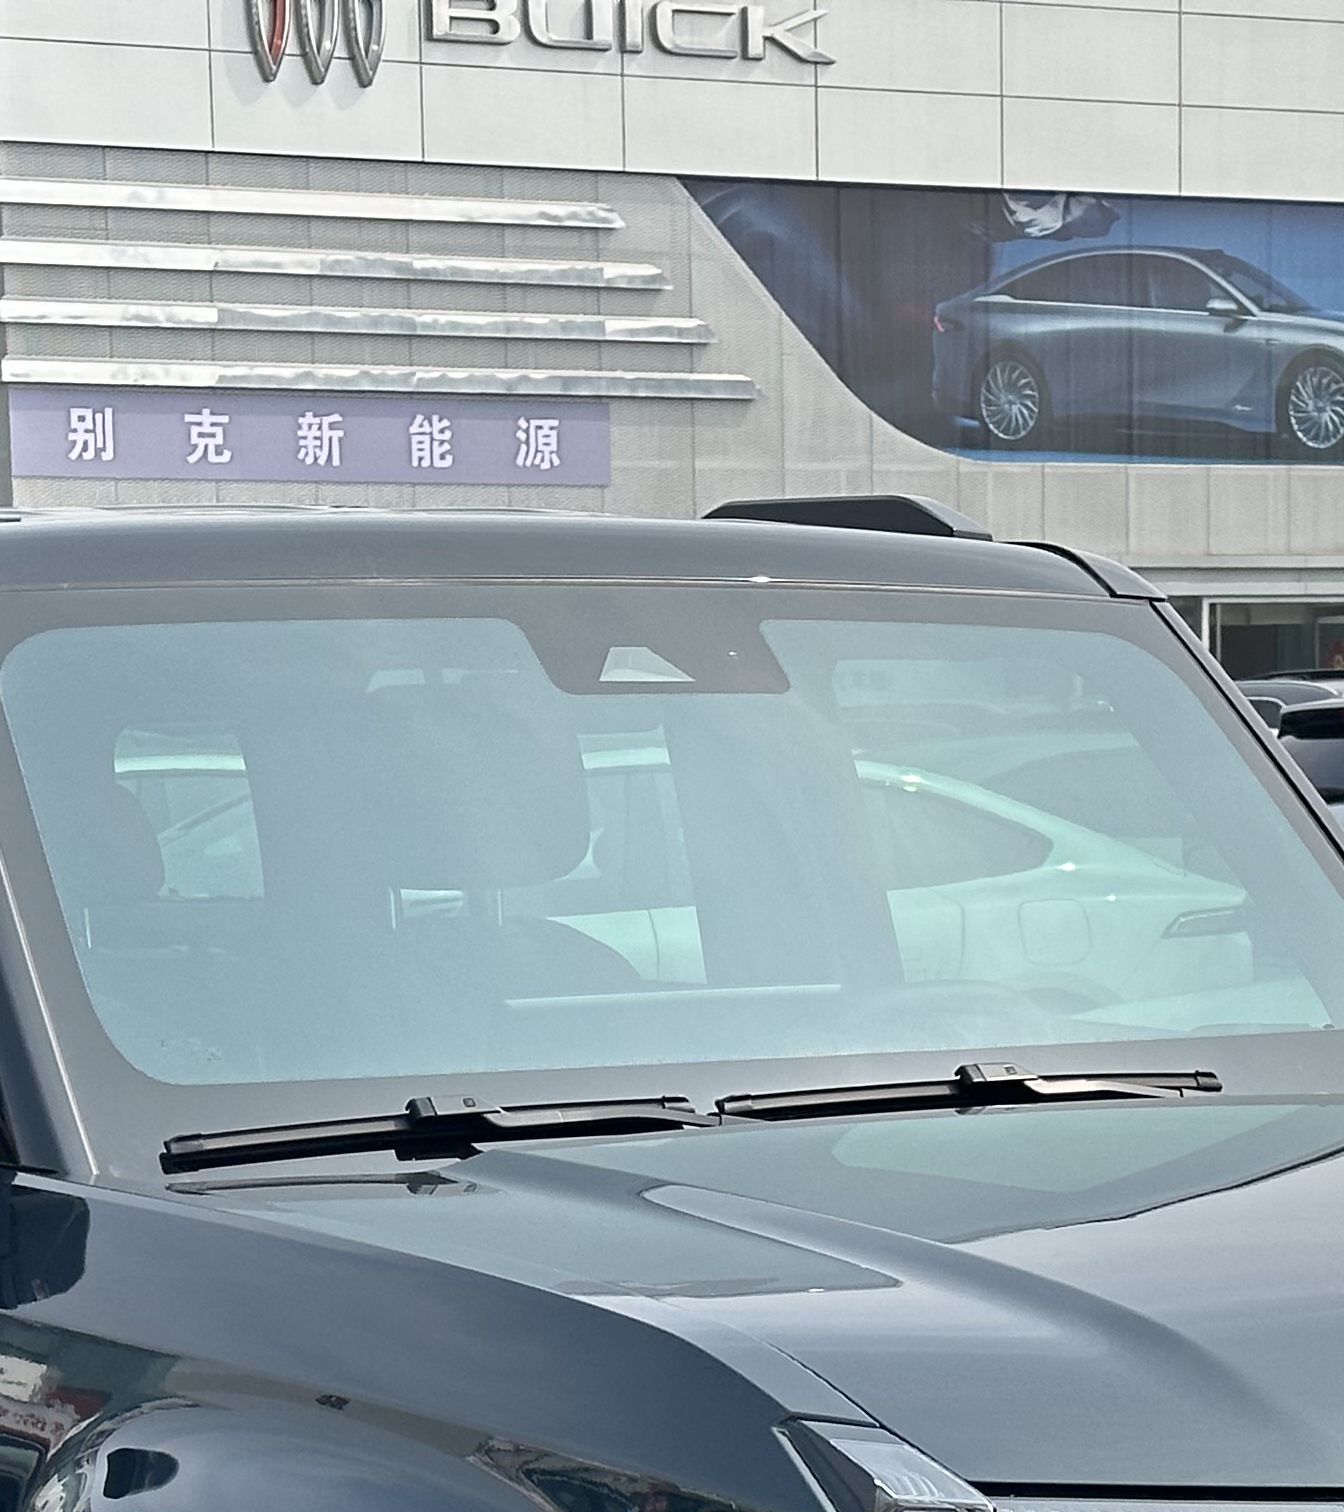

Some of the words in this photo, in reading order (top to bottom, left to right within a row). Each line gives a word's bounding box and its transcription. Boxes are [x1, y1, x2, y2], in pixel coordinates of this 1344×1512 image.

[431, 0, 836, 64] BUICK
[67, 407, 561, 470] 别克新能源
